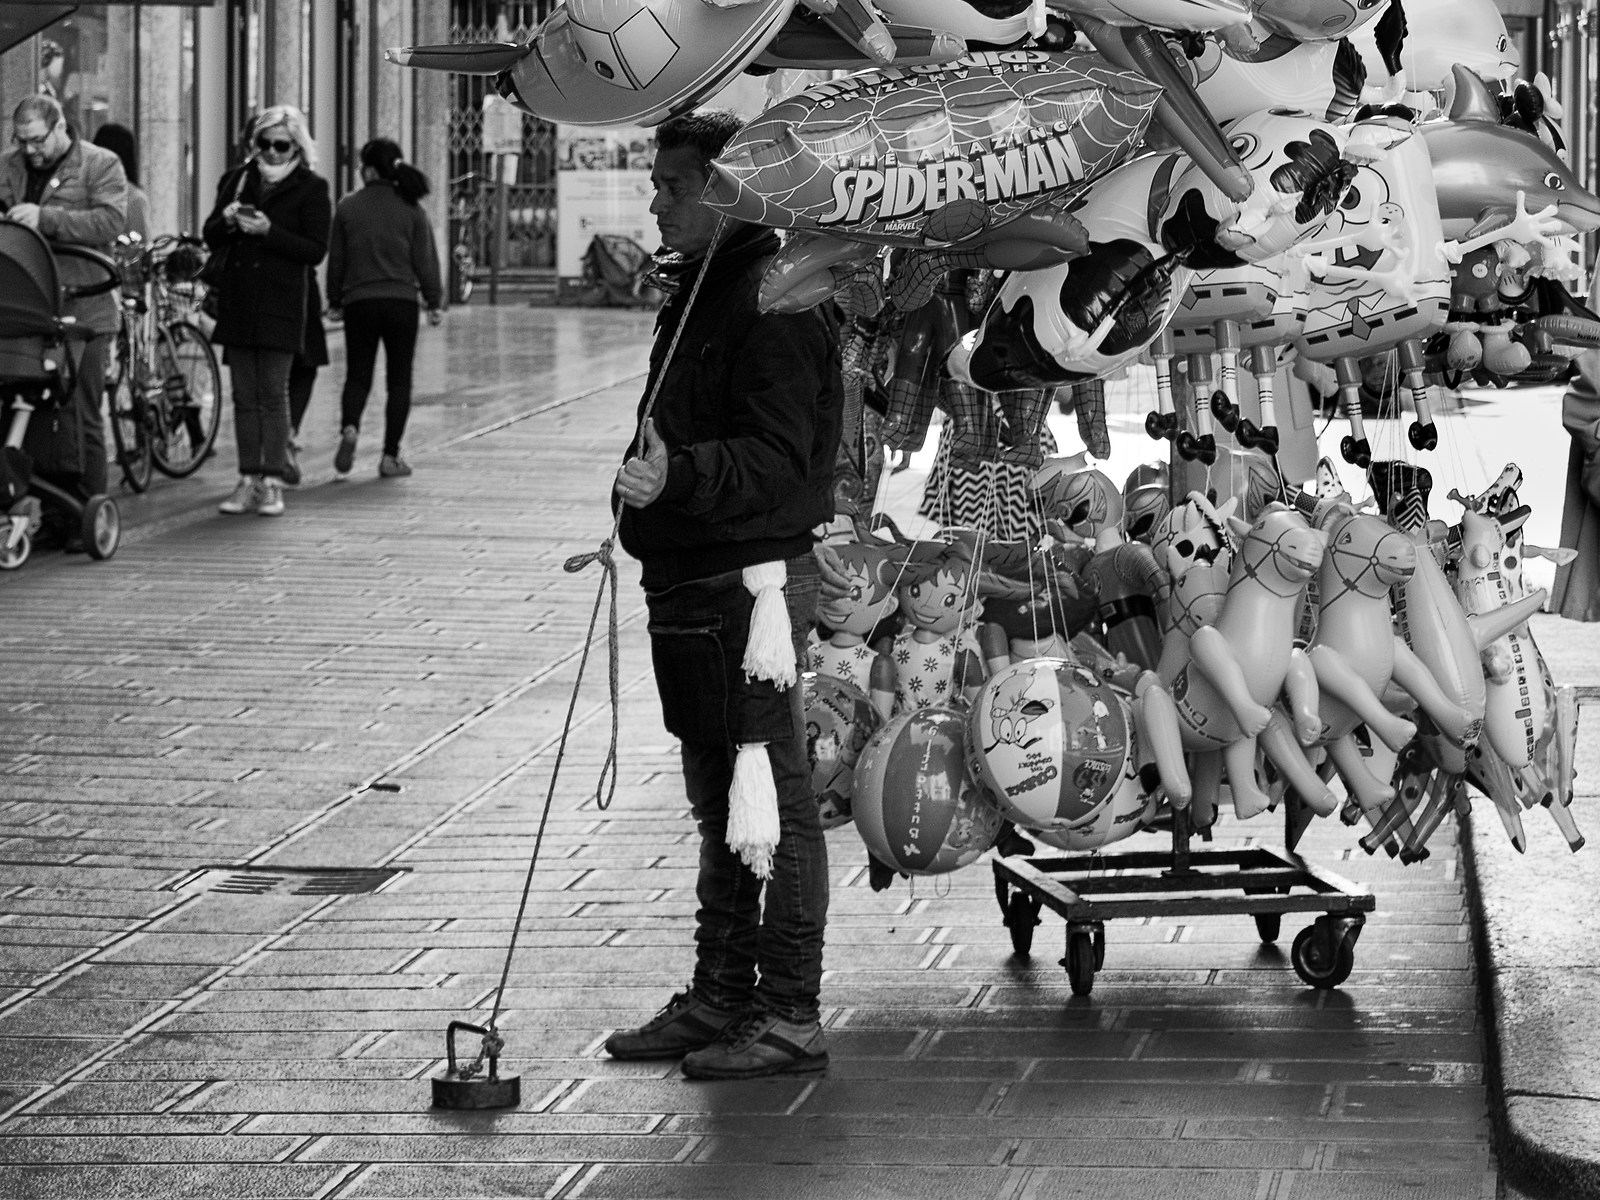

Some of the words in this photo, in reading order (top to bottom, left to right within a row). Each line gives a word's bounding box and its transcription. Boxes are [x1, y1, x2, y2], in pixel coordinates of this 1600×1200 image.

[819, 68, 969, 110] AMAZING
[987, 64, 1050, 76] THE
[836, 152, 898, 170] THE
[917, 120, 1069, 164] AMAZING
[817, 133, 1087, 226] SPIDER-MAN
[884, 221, 916, 231] MARVEL
